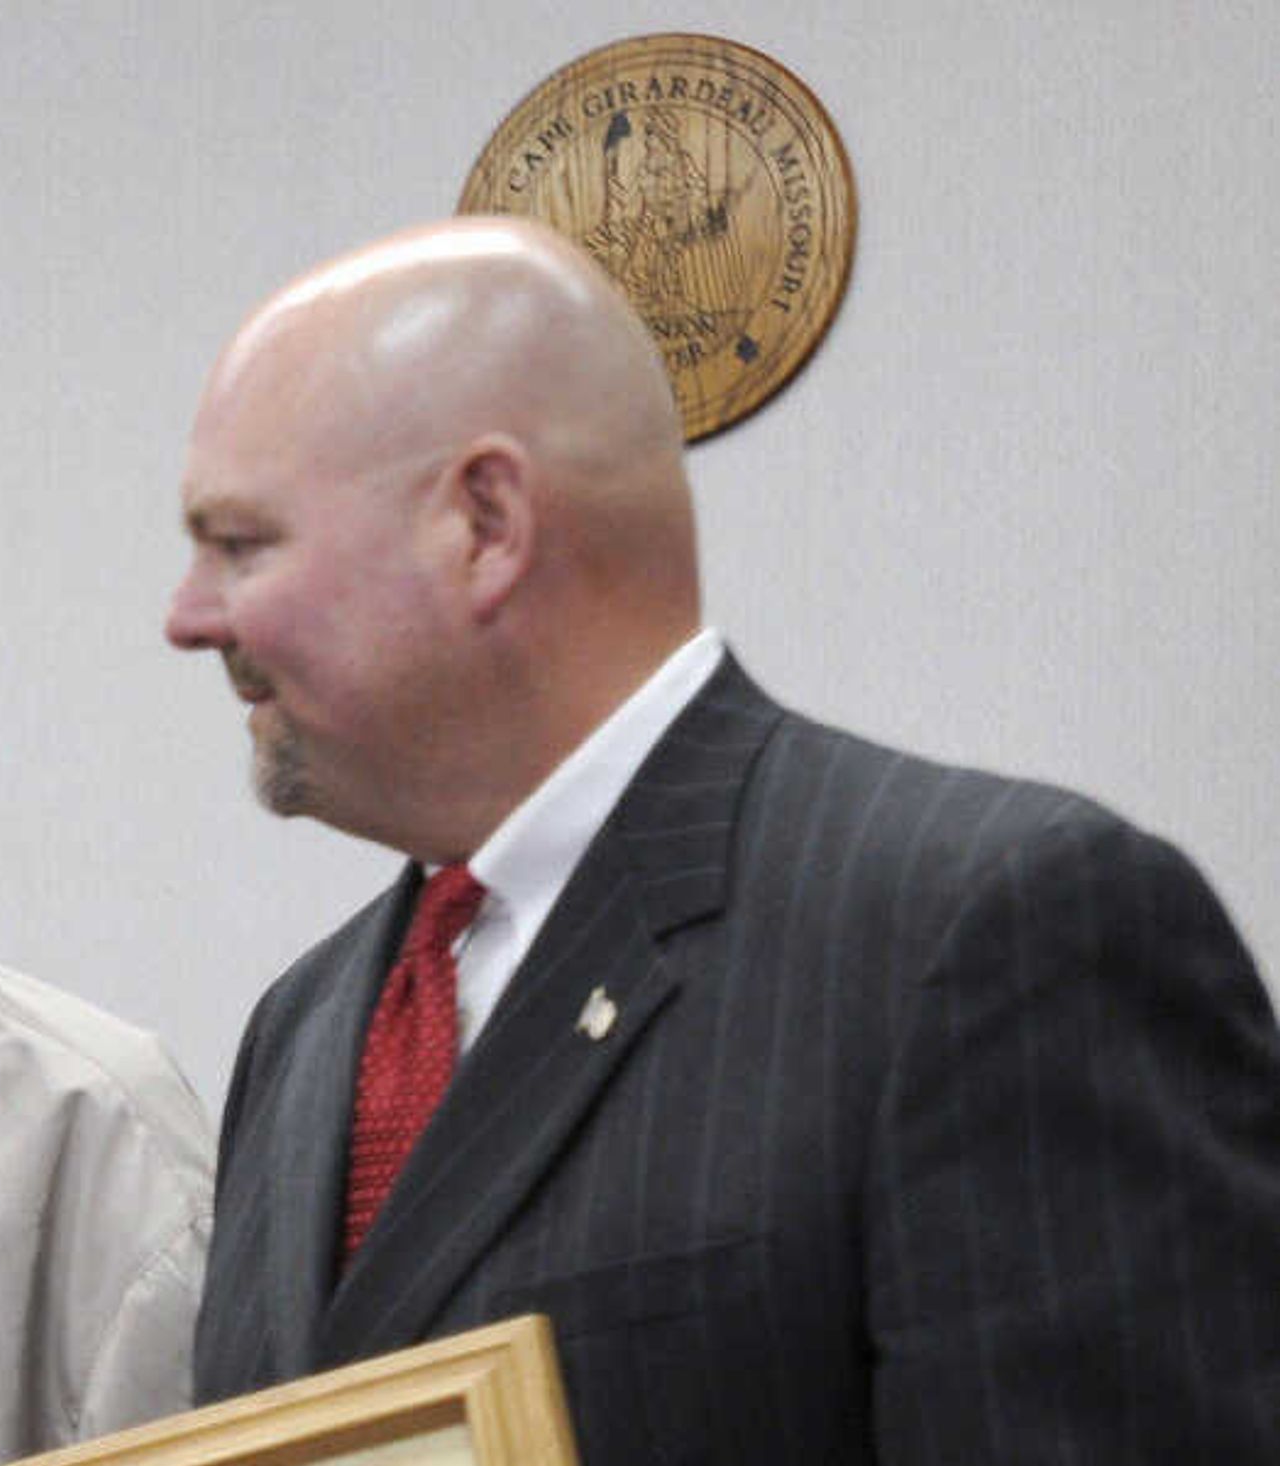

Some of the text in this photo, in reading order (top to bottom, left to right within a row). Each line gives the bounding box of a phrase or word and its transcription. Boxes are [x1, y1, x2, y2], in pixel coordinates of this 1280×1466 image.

[509, 76, 814, 313] CAPE GIRARDEAU MISSOURI
